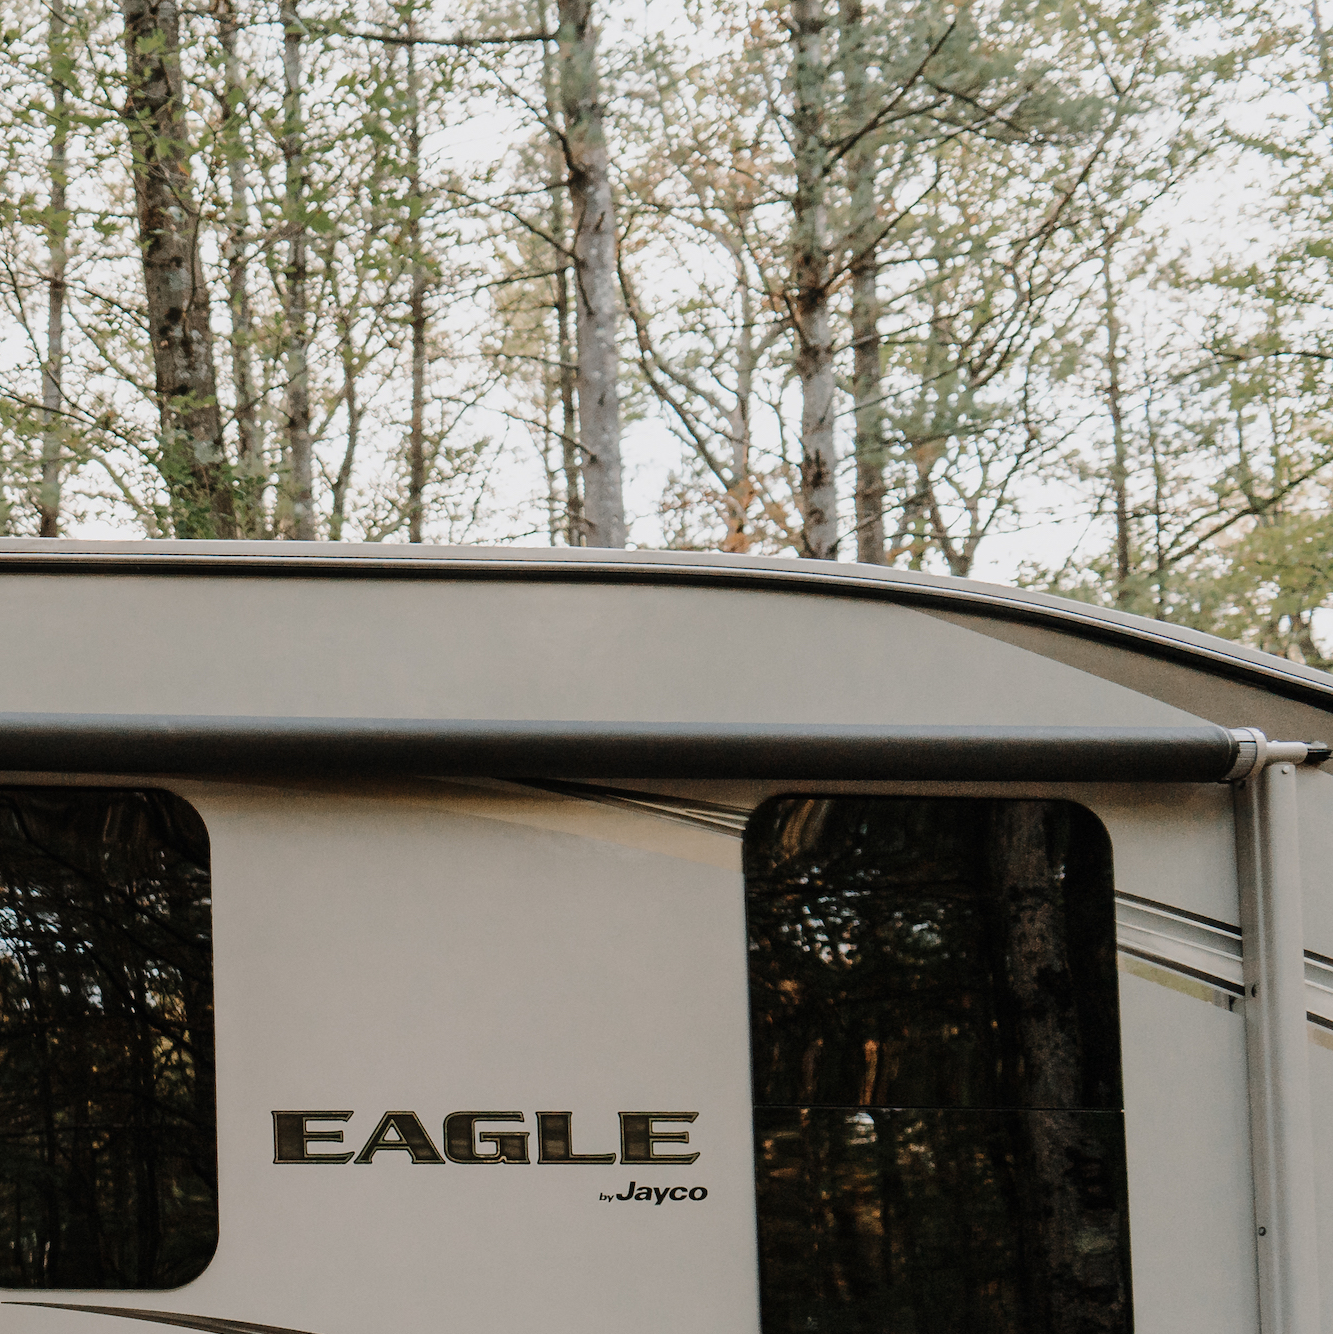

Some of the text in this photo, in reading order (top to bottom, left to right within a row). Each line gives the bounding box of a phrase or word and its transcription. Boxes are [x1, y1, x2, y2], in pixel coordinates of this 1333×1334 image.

[271, 1109, 701, 1165] EAGLE
[599, 1180, 709, 1206] by Jayco
